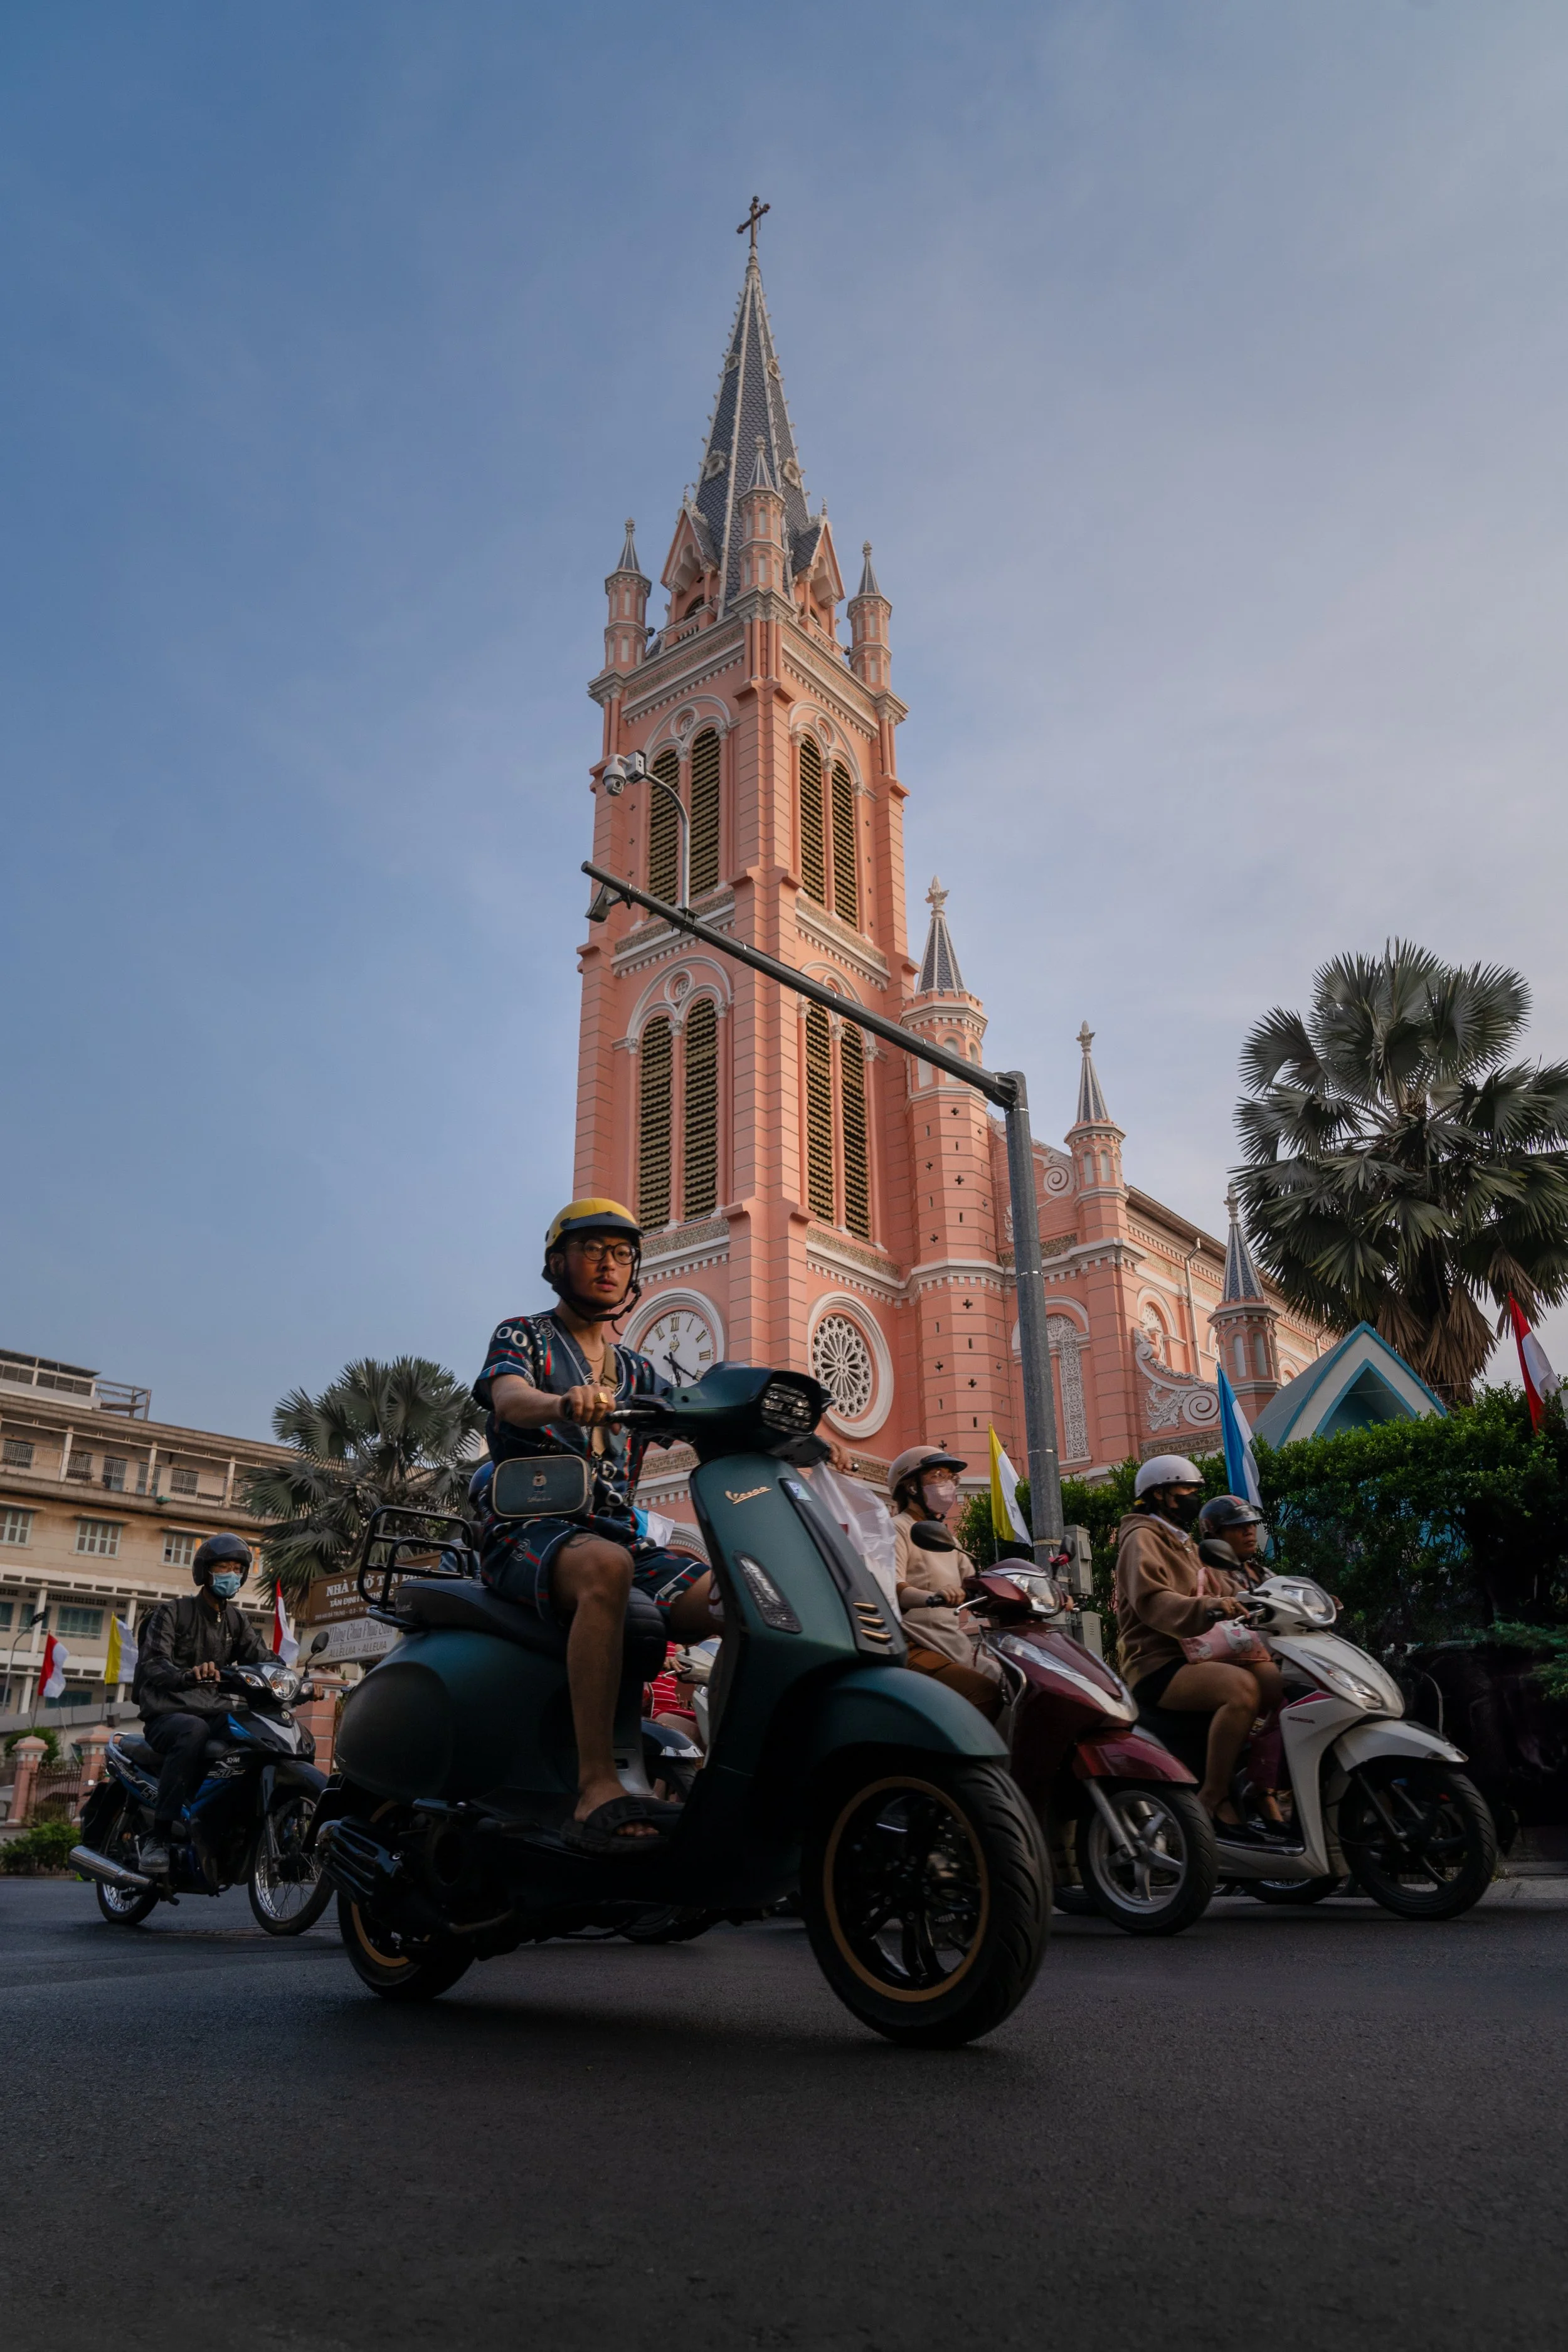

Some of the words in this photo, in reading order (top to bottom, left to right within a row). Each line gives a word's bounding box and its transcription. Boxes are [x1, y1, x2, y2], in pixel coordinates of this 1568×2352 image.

[725, 1486, 773, 1505] Vespa
[326, 1579, 349, 1597] NHÀ
[377, 1572, 398, 1587] TN
[1287, 1716, 1315, 1724] HONDA
